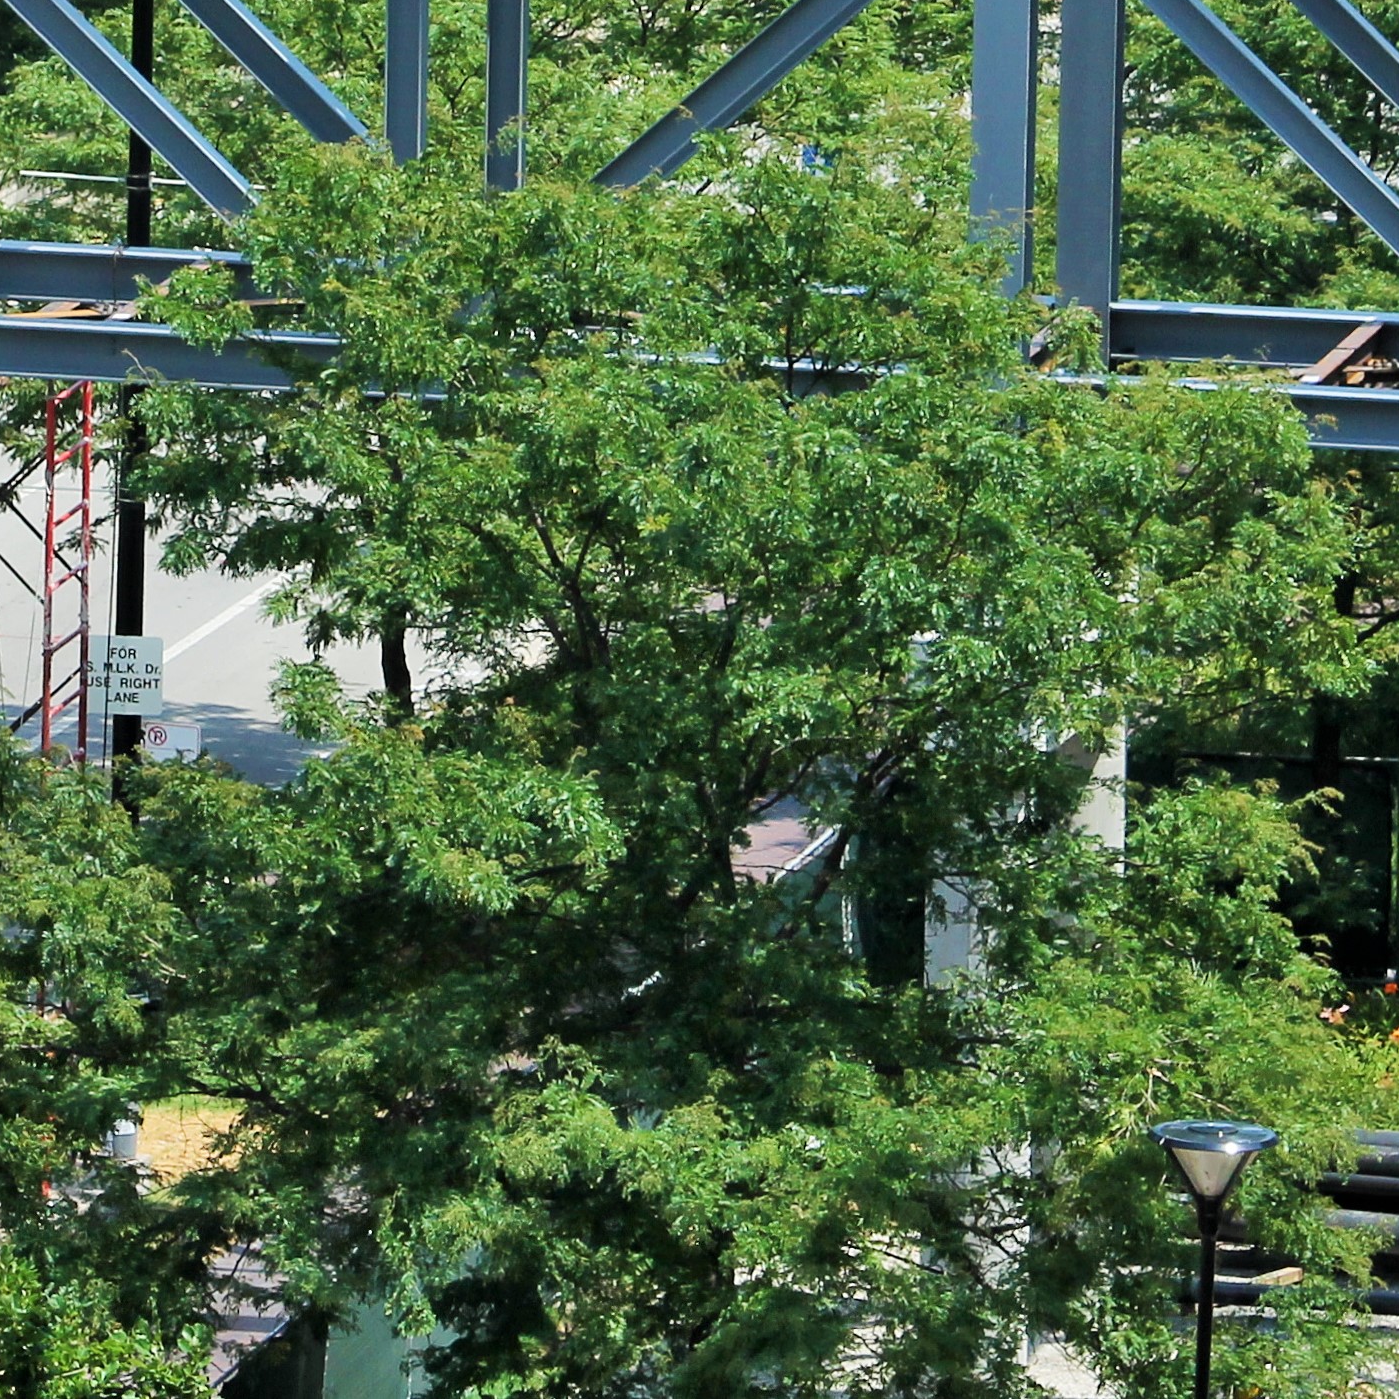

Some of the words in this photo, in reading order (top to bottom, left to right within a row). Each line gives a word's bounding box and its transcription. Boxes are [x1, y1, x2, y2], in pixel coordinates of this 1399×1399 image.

[109, 647, 137, 660] FOR
[145, 663, 162, 675] Dr.
[120, 677, 160, 689] RIGHT
[106, 691, 140, 704] LANE
